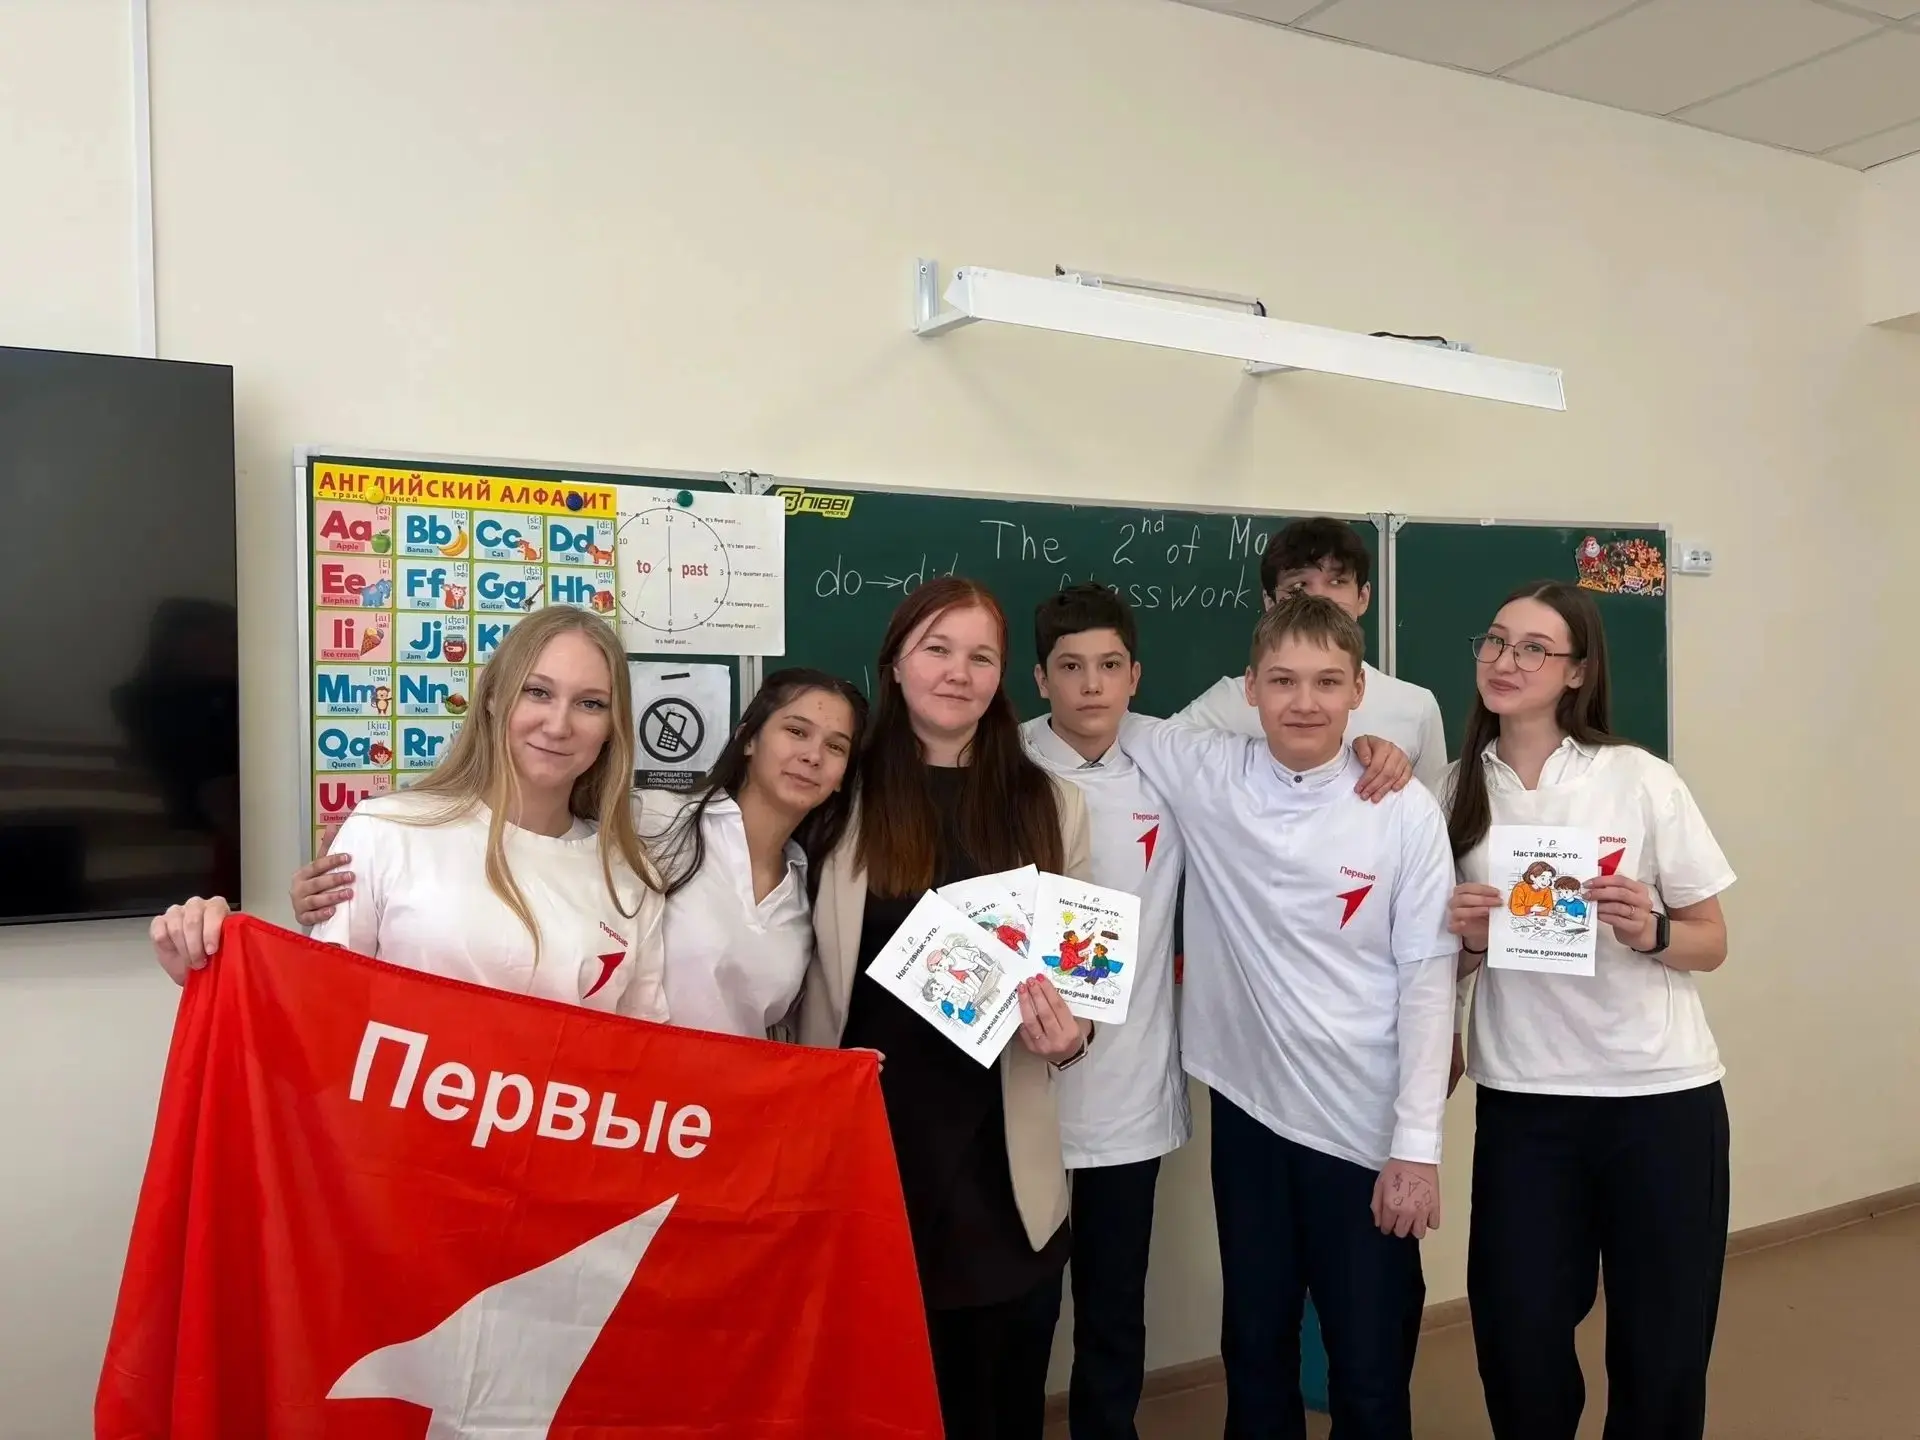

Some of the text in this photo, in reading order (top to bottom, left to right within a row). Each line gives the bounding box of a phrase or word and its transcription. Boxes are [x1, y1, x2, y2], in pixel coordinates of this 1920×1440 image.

[319, 471, 611, 510] АНГЛИЙСКИЙ АЛФАИТ
[333, 491, 418, 503] транспцией
[320, 510, 372, 541] Aa
[406, 515, 452, 545] Bb
[476, 520, 522, 549] Cc
[641, 517, 649, 525] 11
[336, 543, 359, 551] Apple
[550, 524, 594, 553] Dd
[619, 537, 628, 545] 10
[713, 544, 719, 552] 2
[980, 520, 1067, 563] The
[1166, 525, 1200, 564] of
[1228, 516, 1268, 560] Ma
[492, 549, 505, 558] Cat
[565, 555, 579, 563] Dog
[636, 559, 652, 574] to
[322, 564, 366, 595] Ee
[407, 568, 447, 598] Ff
[682, 563, 709, 579] past
[815, 554, 862, 597] do
[323, 597, 358, 605] Elephant
[477, 572, 526, 609] Gg
[551, 575, 597, 603] Hh
[640, 610, 646, 618] 7
[409, 621, 442, 659] Jj
[318, 674, 376, 702] Mm
[400, 675, 449, 703] Nn
[330, 706, 359, 714] Monkey
[318, 728, 370, 764] Qq
[404, 728, 444, 757] Rr
[331, 761, 356, 769] Queen
[319, 783, 370, 812] Uu
[1132, 812, 1160, 821] Первые
[1598, 835, 1627, 844] рвые
[1339, 866, 1377, 882] Первые
[599, 920, 629, 948] Первые
[1506, 947, 1539, 955] источник
[1540, 949, 1588, 959] вдохновения
[998, 989, 1018, 1015] поддер
[1056, 987, 1089, 999] теводная
[1090, 994, 1115, 1005] звезда
[349, 1020, 712, 1159] Первые
